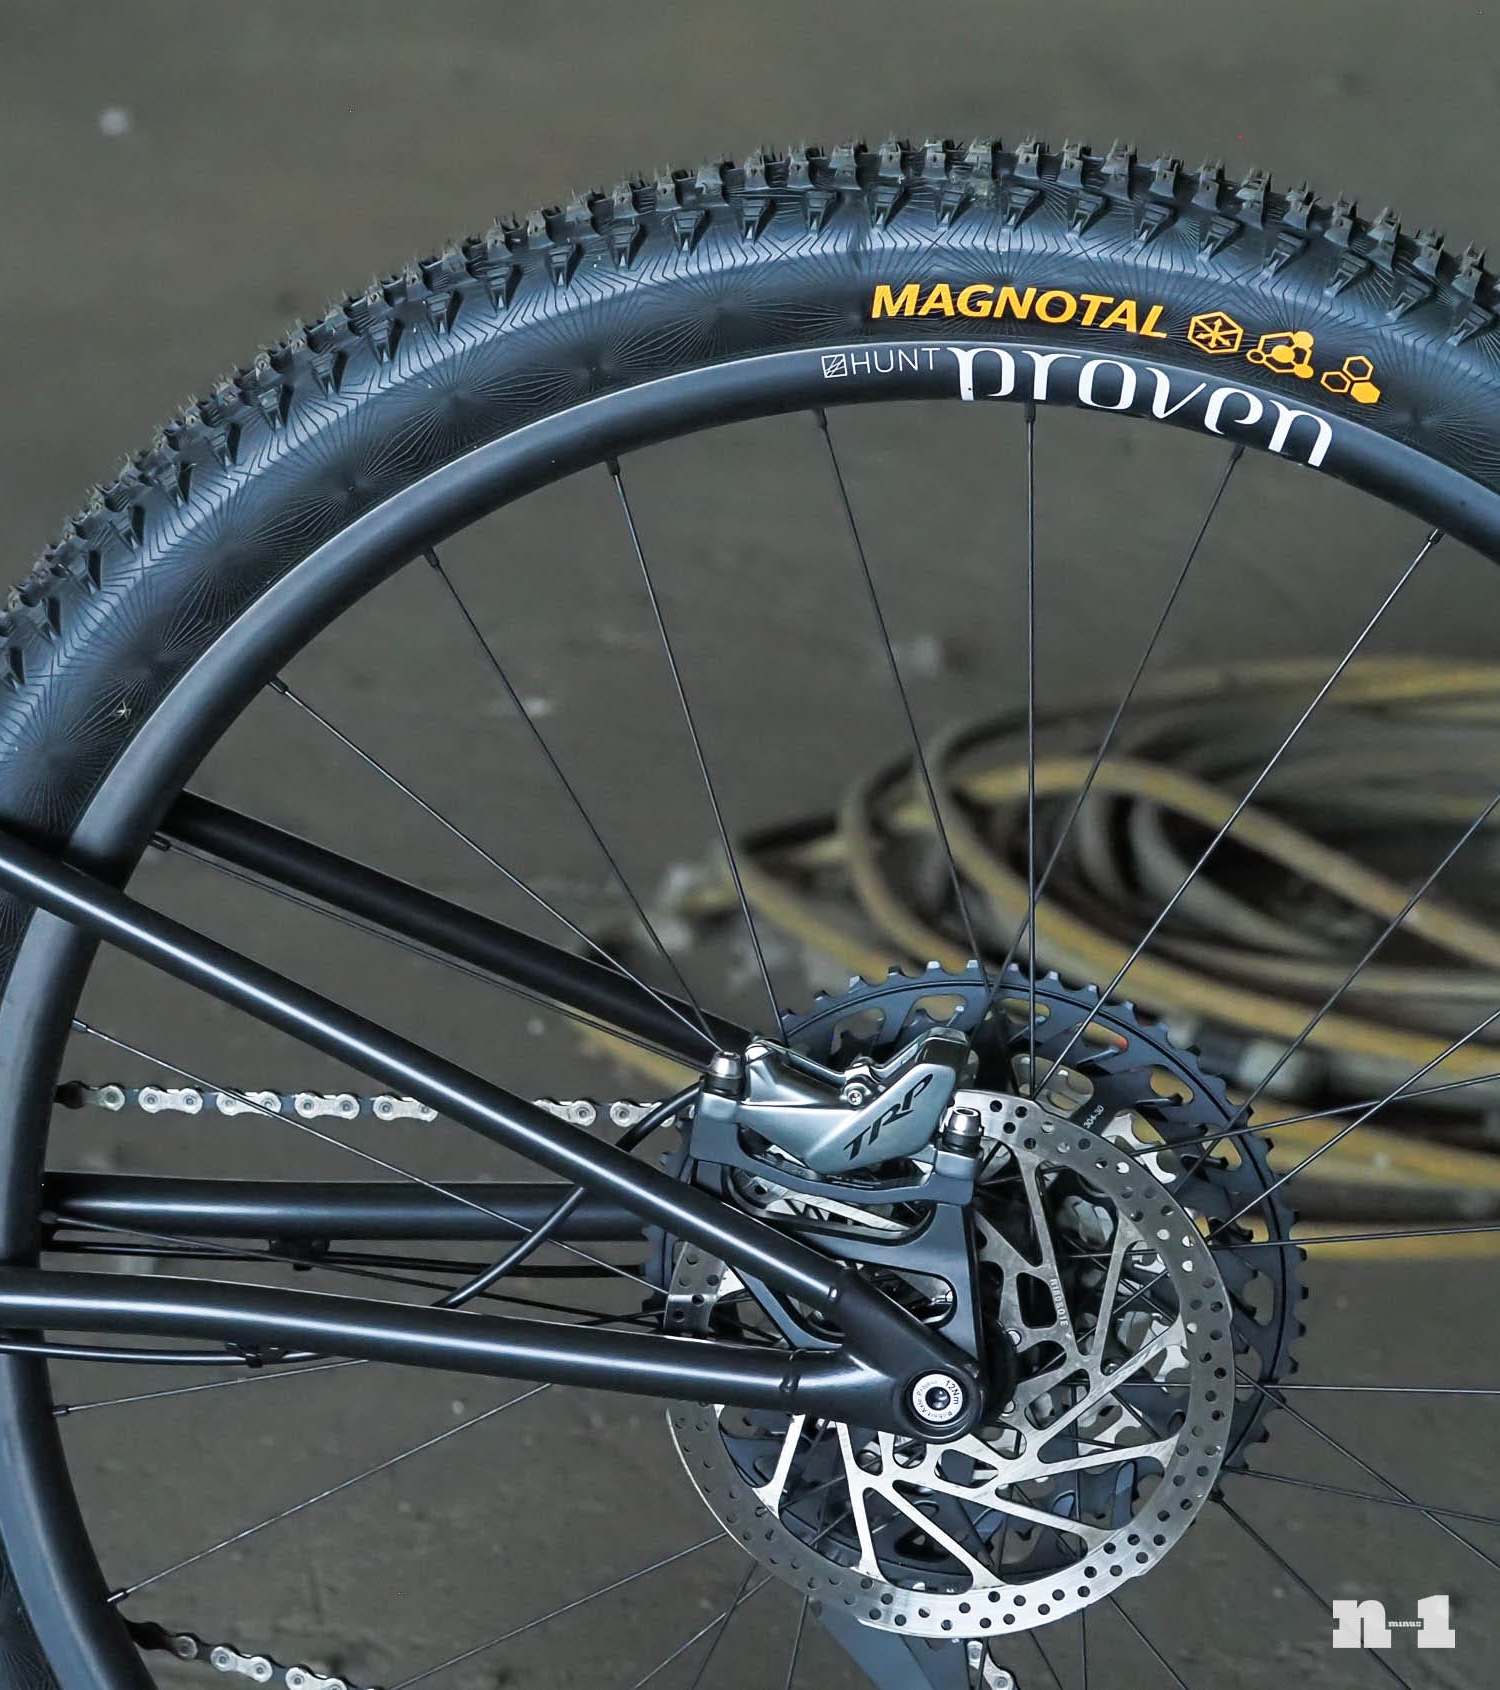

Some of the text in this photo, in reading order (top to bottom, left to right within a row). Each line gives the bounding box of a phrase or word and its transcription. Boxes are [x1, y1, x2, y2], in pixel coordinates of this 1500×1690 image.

[871, 283, 1168, 339] MAGNOTAL
[851, 346, 1334, 468] HUNT proven
[843, 1073, 934, 1161] TRP
